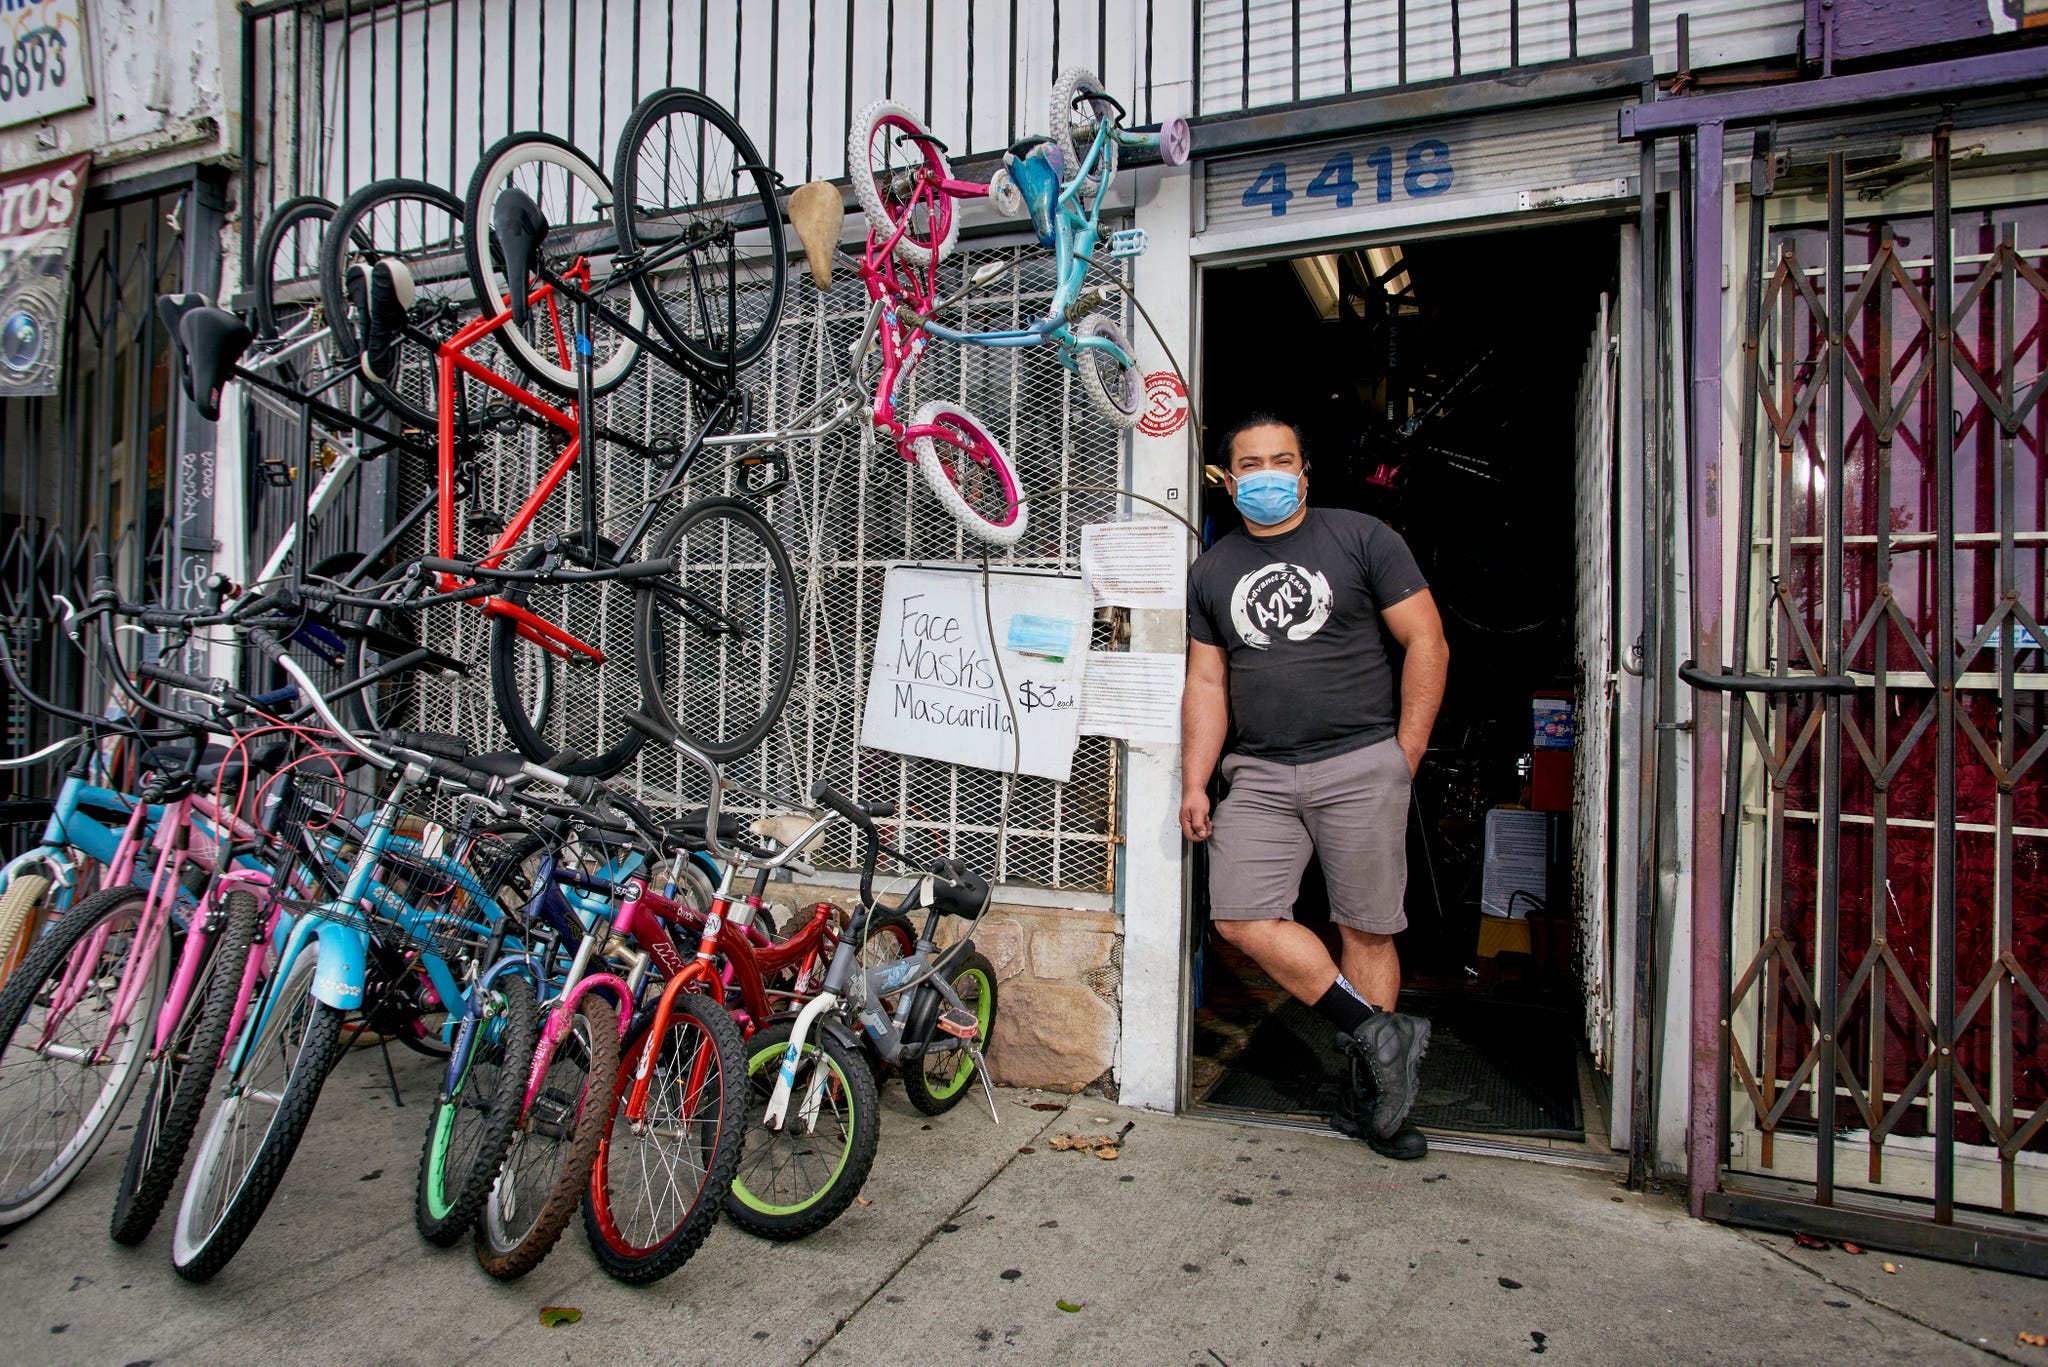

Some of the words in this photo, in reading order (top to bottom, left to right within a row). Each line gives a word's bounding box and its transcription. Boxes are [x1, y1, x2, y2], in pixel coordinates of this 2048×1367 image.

[0, 29, 66, 101] 6893
[0, 169, 77, 234] TOS
[1242, 139, 1454, 217] 4418
[1143, 417, 1159, 428] Bike
[1159, 416, 1177, 428] Shop
[1247, 574, 1279, 606] Advance
[1280, 572, 1288, 581] 2
[1288, 575, 1307, 595] Race
[1255, 582, 1303, 628] A2R
[901, 593, 963, 643] Face
[896, 638, 994, 690] Masks
[894, 683, 1014, 735] Mascarilla
[1018, 679, 1057, 714] $3
[1057, 696, 1075, 709] each
